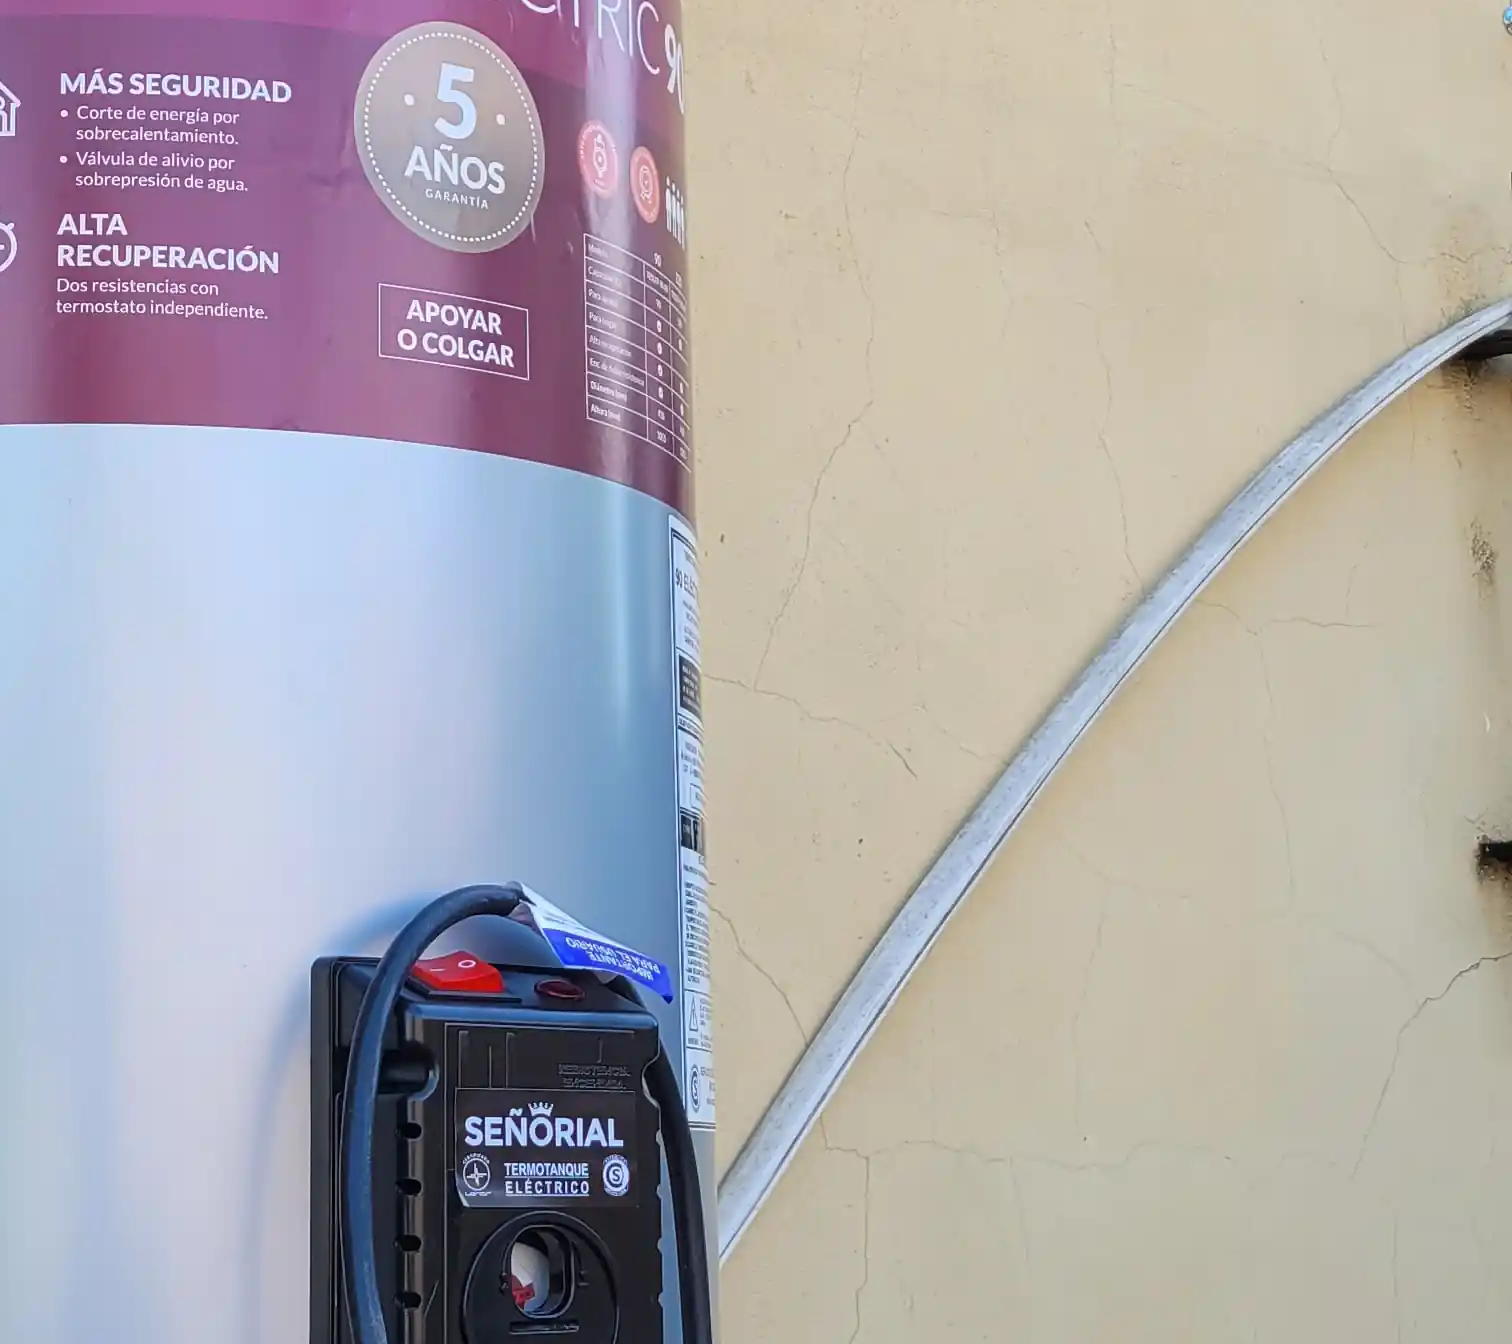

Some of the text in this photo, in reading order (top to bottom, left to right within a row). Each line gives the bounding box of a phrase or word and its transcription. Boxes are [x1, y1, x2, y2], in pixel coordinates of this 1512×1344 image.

[60, 68, 292, 103] MÁS SEGURIDAD
[434, 61, 478, 140] 5
[76, 106, 240, 125] Corte de energía por
[76, 126, 239, 145] sobrecalentamiento.
[76, 151, 235, 172] Válvula de alivio por
[404, 143, 506, 194] AÑOS
[75, 172, 248, 193] sobrepresión de agua.
[425, 188, 489, 210] GARANTÍA
[56, 213, 129, 236] ALTA
[57, 244, 280, 274] RECUPERACIÓN
[57, 278, 219, 296] Dos resistencias con
[56, 299, 269, 320] termostato independiente.
[406, 299, 503, 336] APOYAR
[397, 328, 515, 368] O COLGAR
[464, 1108, 625, 1147] SEÑORIAL
[504, 1162, 589, 1177] TERMOTANQUE
[504, 1178, 590, 1194] ELÉCTRICO
